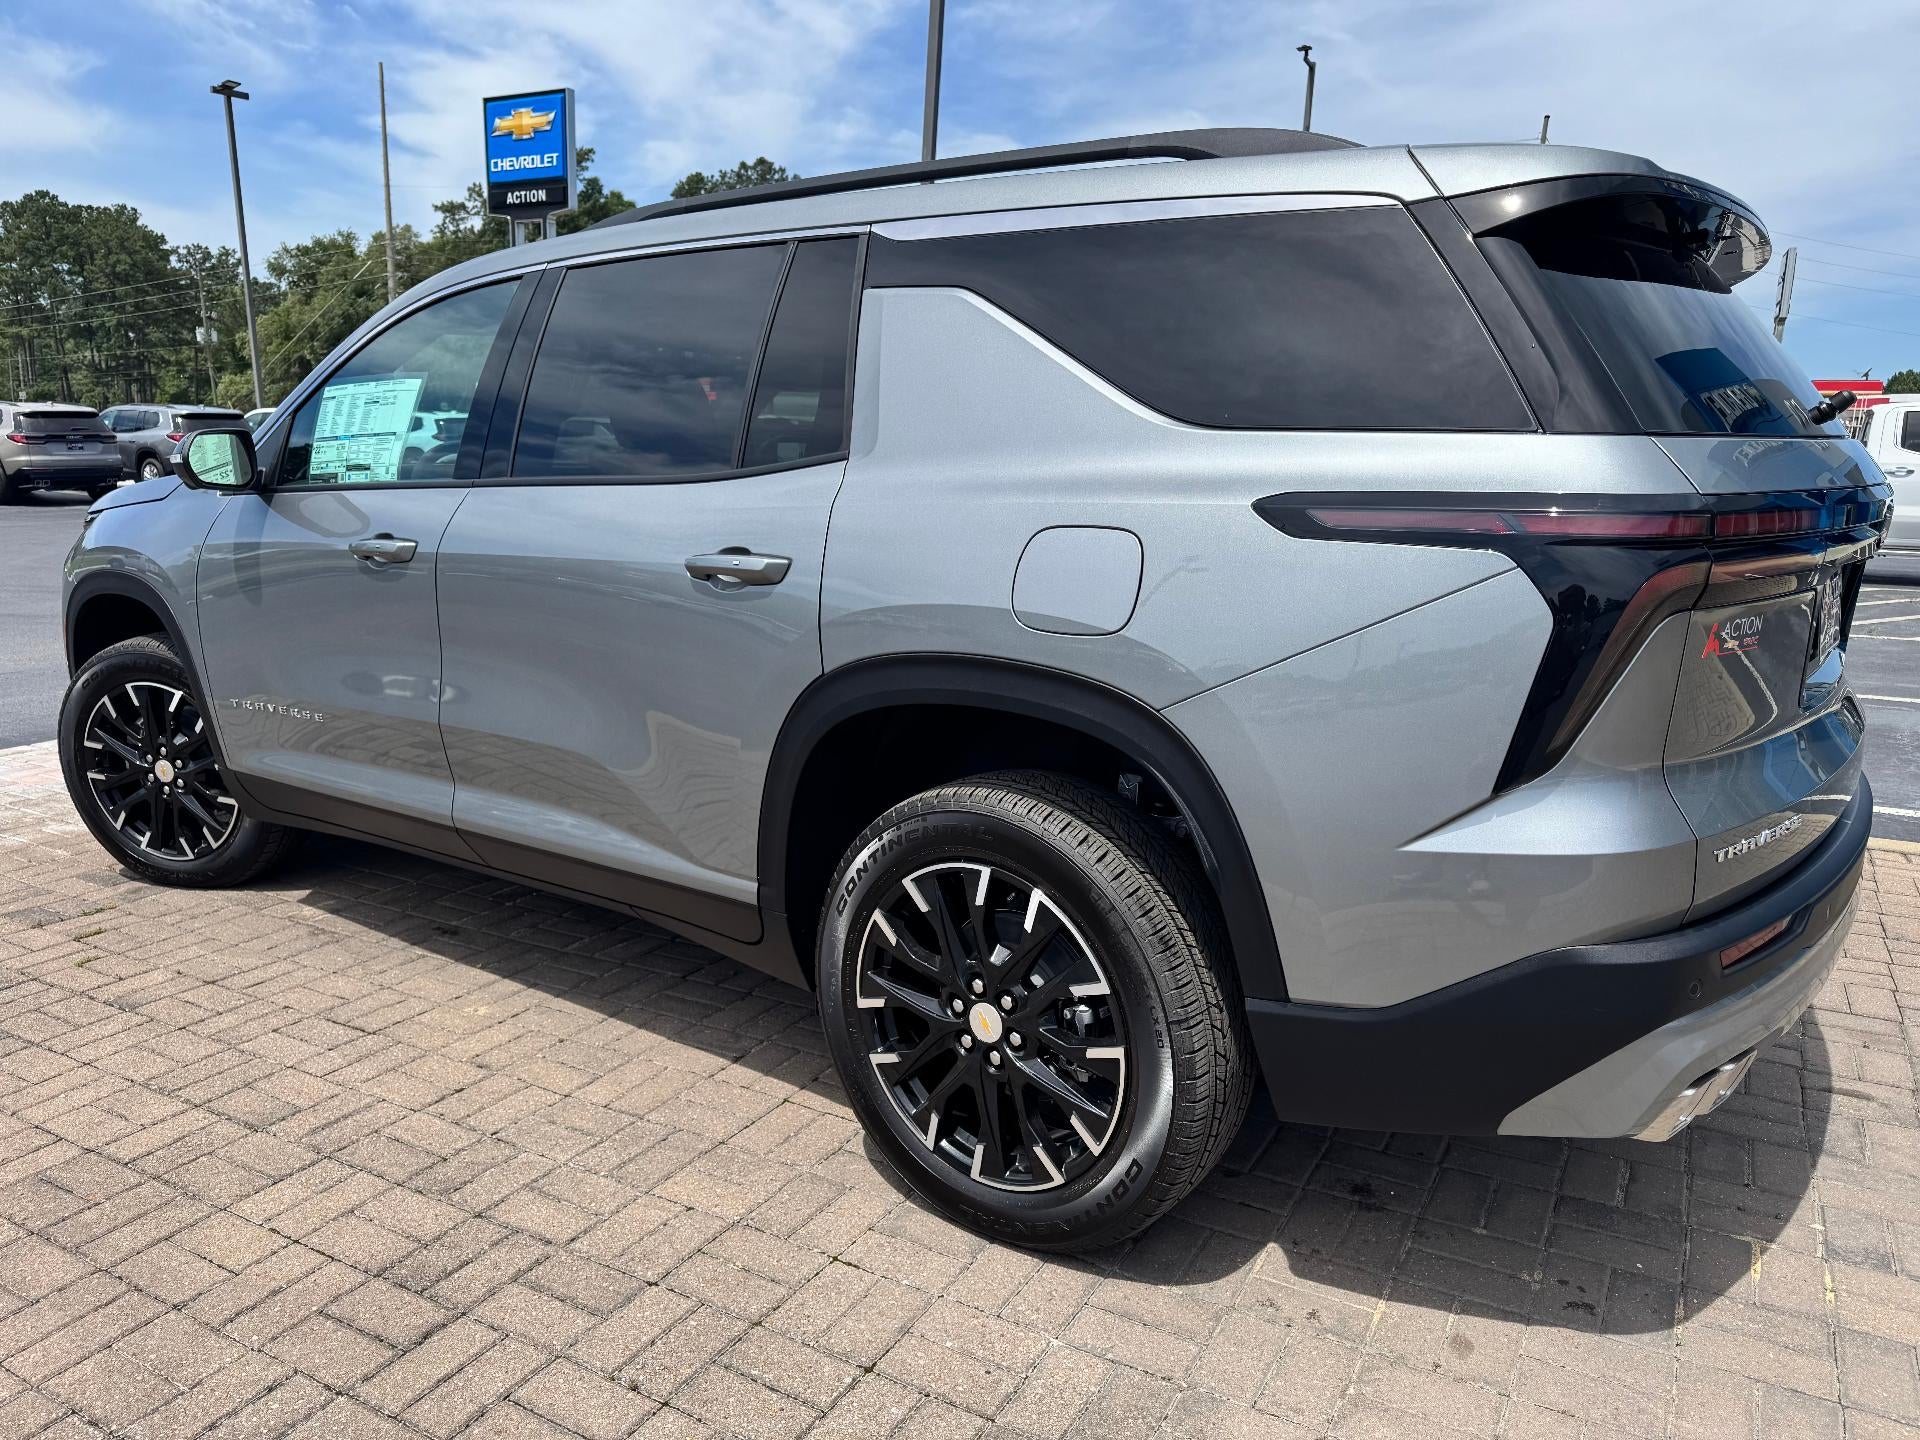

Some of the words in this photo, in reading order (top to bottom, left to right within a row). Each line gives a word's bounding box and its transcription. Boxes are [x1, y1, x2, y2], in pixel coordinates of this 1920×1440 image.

[490, 153, 559, 172] CHEVROLET
[506, 189, 546, 205] ACTION
[1724, 614, 1764, 637] ACTION
[229, 698, 324, 722] TRAVERSE
[1713, 813, 1802, 863] TRAVERSE
